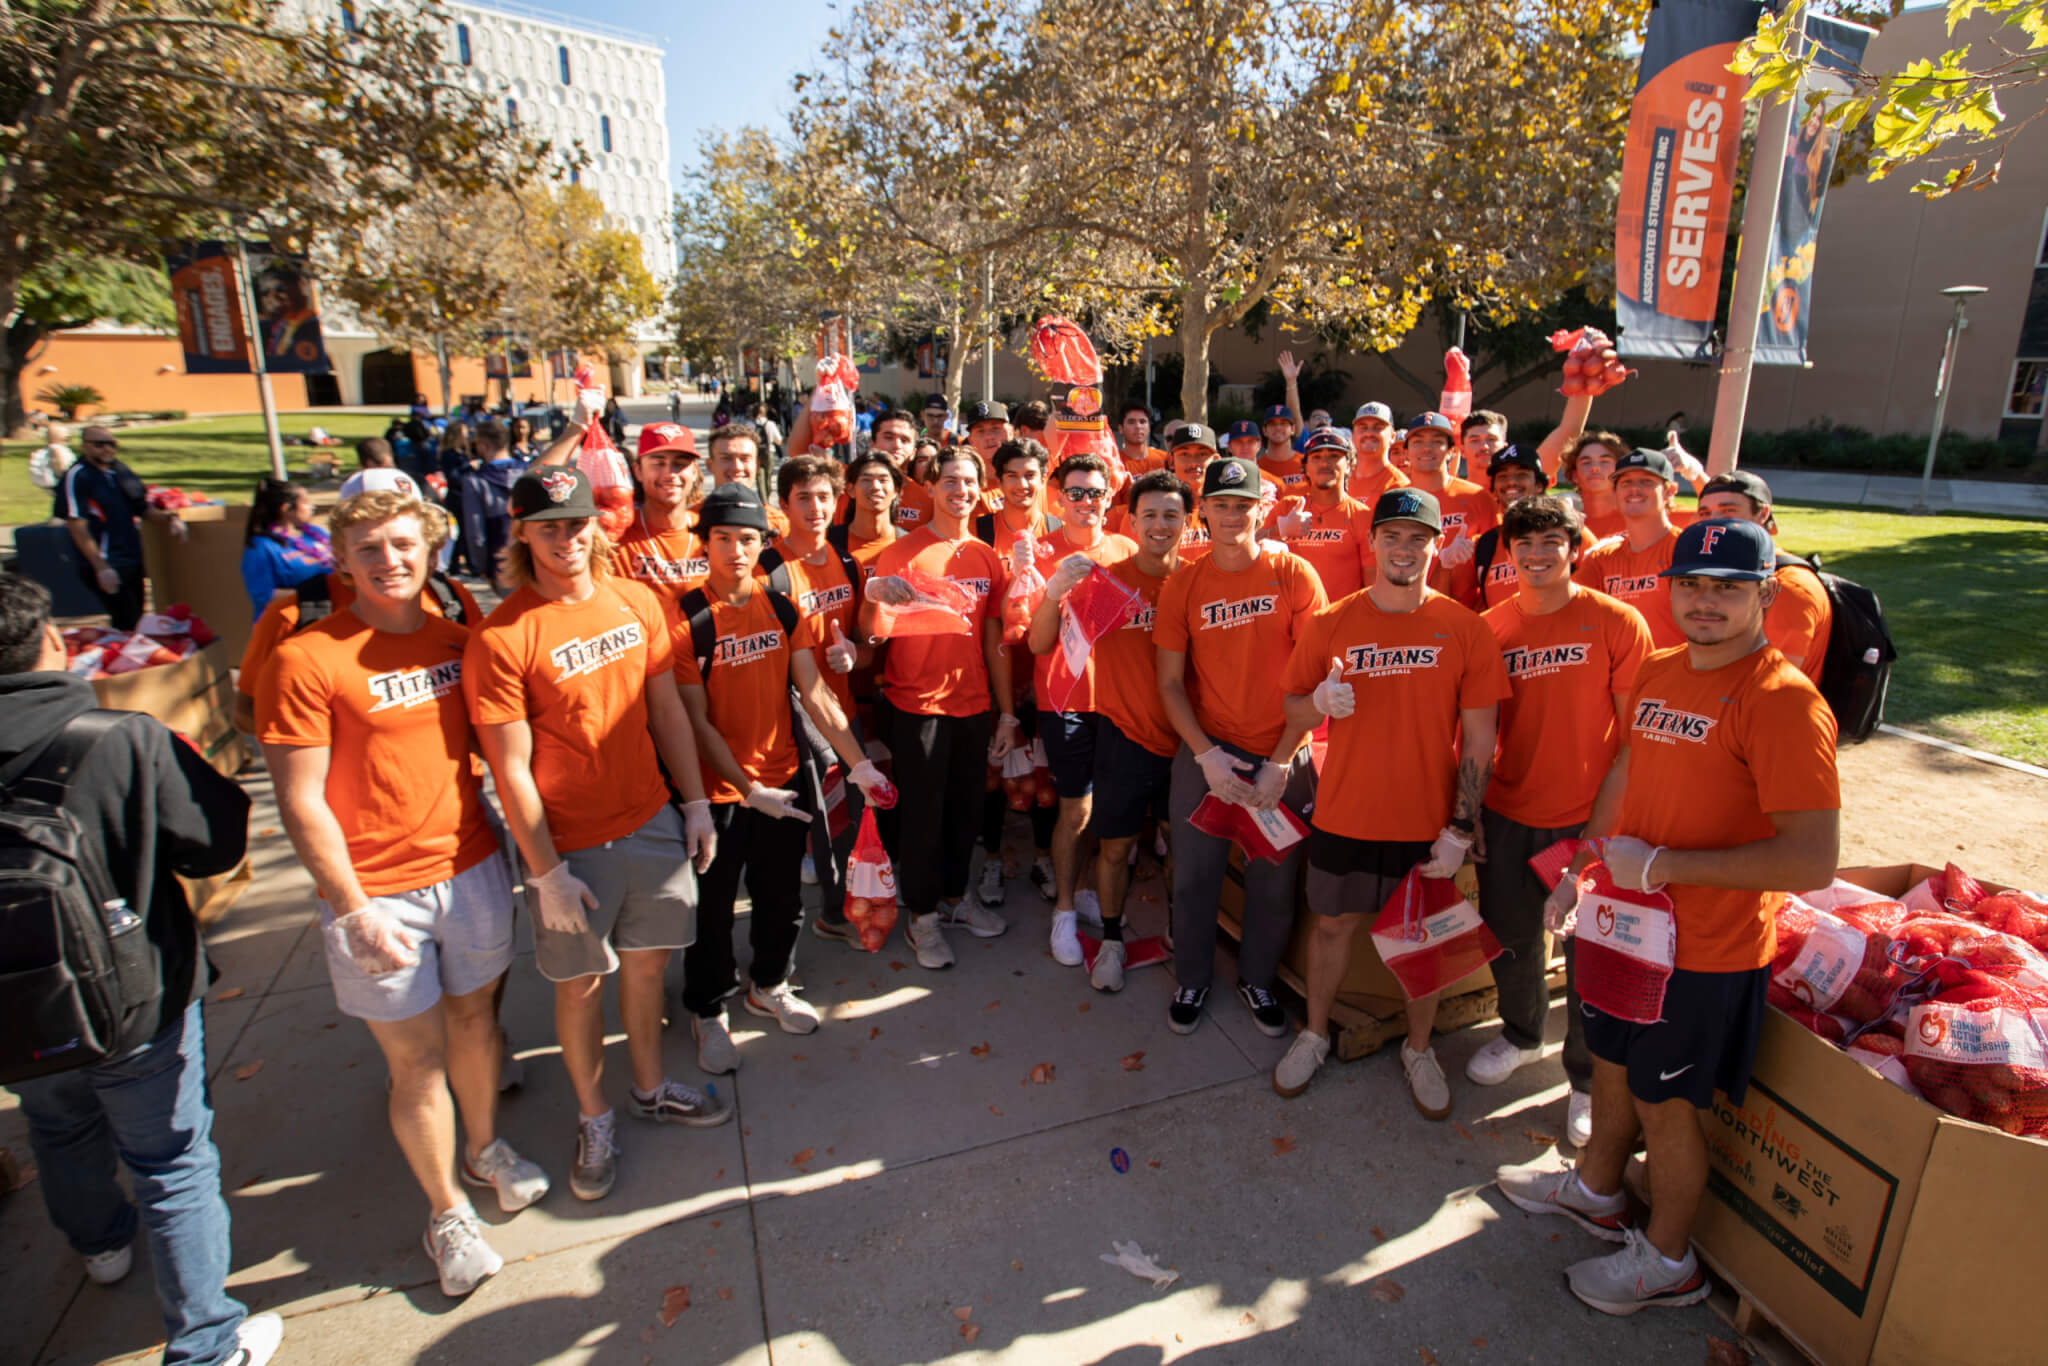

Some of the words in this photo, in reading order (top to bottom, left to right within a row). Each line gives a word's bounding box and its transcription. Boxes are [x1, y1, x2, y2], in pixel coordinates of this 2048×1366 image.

[1656, 136, 1670, 159] INC
[1647, 161, 1666, 228] STUDENTS
[1666, 86, 1726, 289] SERVES.
[1643, 229, 1658, 304] ASSOCIATED
[1699, 526, 1727, 555] F
[1204, 598, 1273, 625] TITANS
[555, 627, 640, 672] TITANS
[713, 633, 779, 660] TITANS
[1349, 647, 1435, 671] TITANS
[1503, 646, 1585, 673] TITANS
[374, 663, 462, 703] TITANS
[1368, 667, 1412, 679] BASEBALL
[1635, 702, 1710, 738] TITANS
[1950, 1031, 1981, 1043] ACTION
[1951, 1041, 2011, 1054] PARTNERSHIP
[1805, 1159, 1832, 1186] THE
